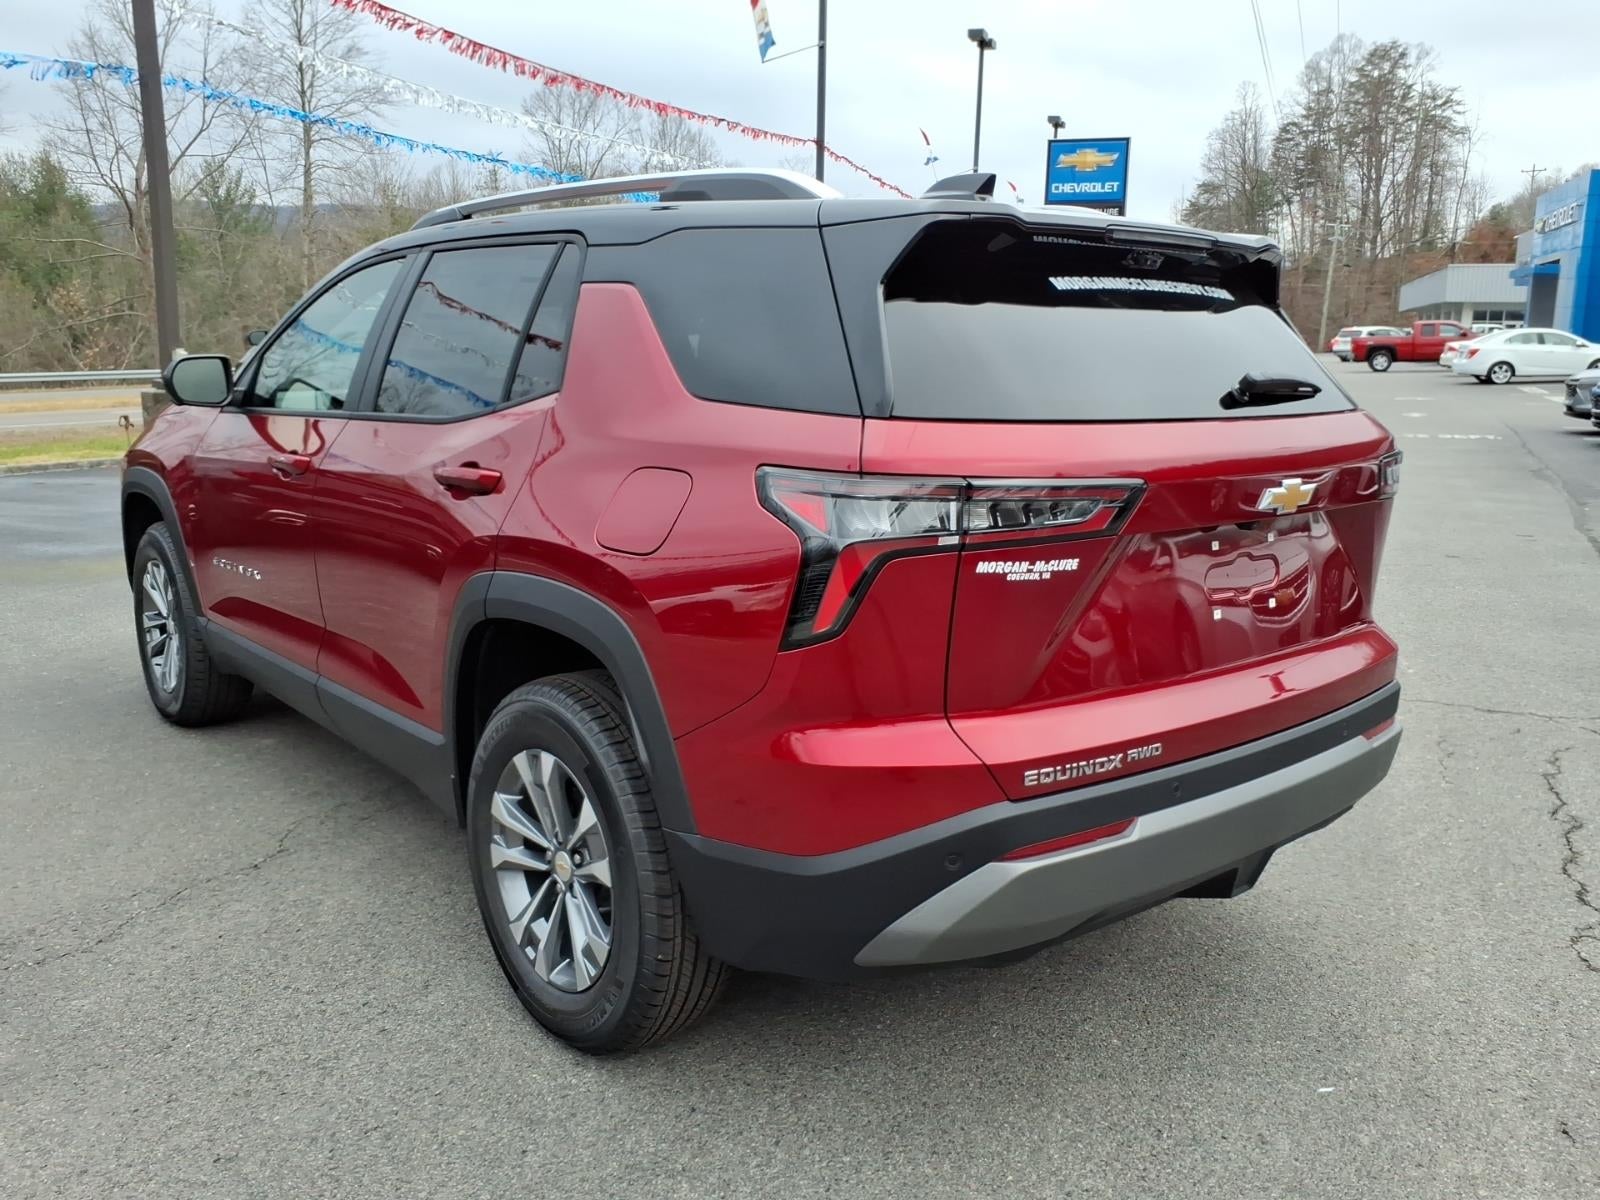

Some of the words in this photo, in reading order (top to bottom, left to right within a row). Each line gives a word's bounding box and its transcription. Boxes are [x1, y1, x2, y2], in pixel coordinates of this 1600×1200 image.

[1051, 181, 1120, 193] CHEVROLET
[1041, 571, 1051, 580] VA
[1024, 754, 1123, 786] EQUINOX
[1127, 743, 1162, 762] AWD
